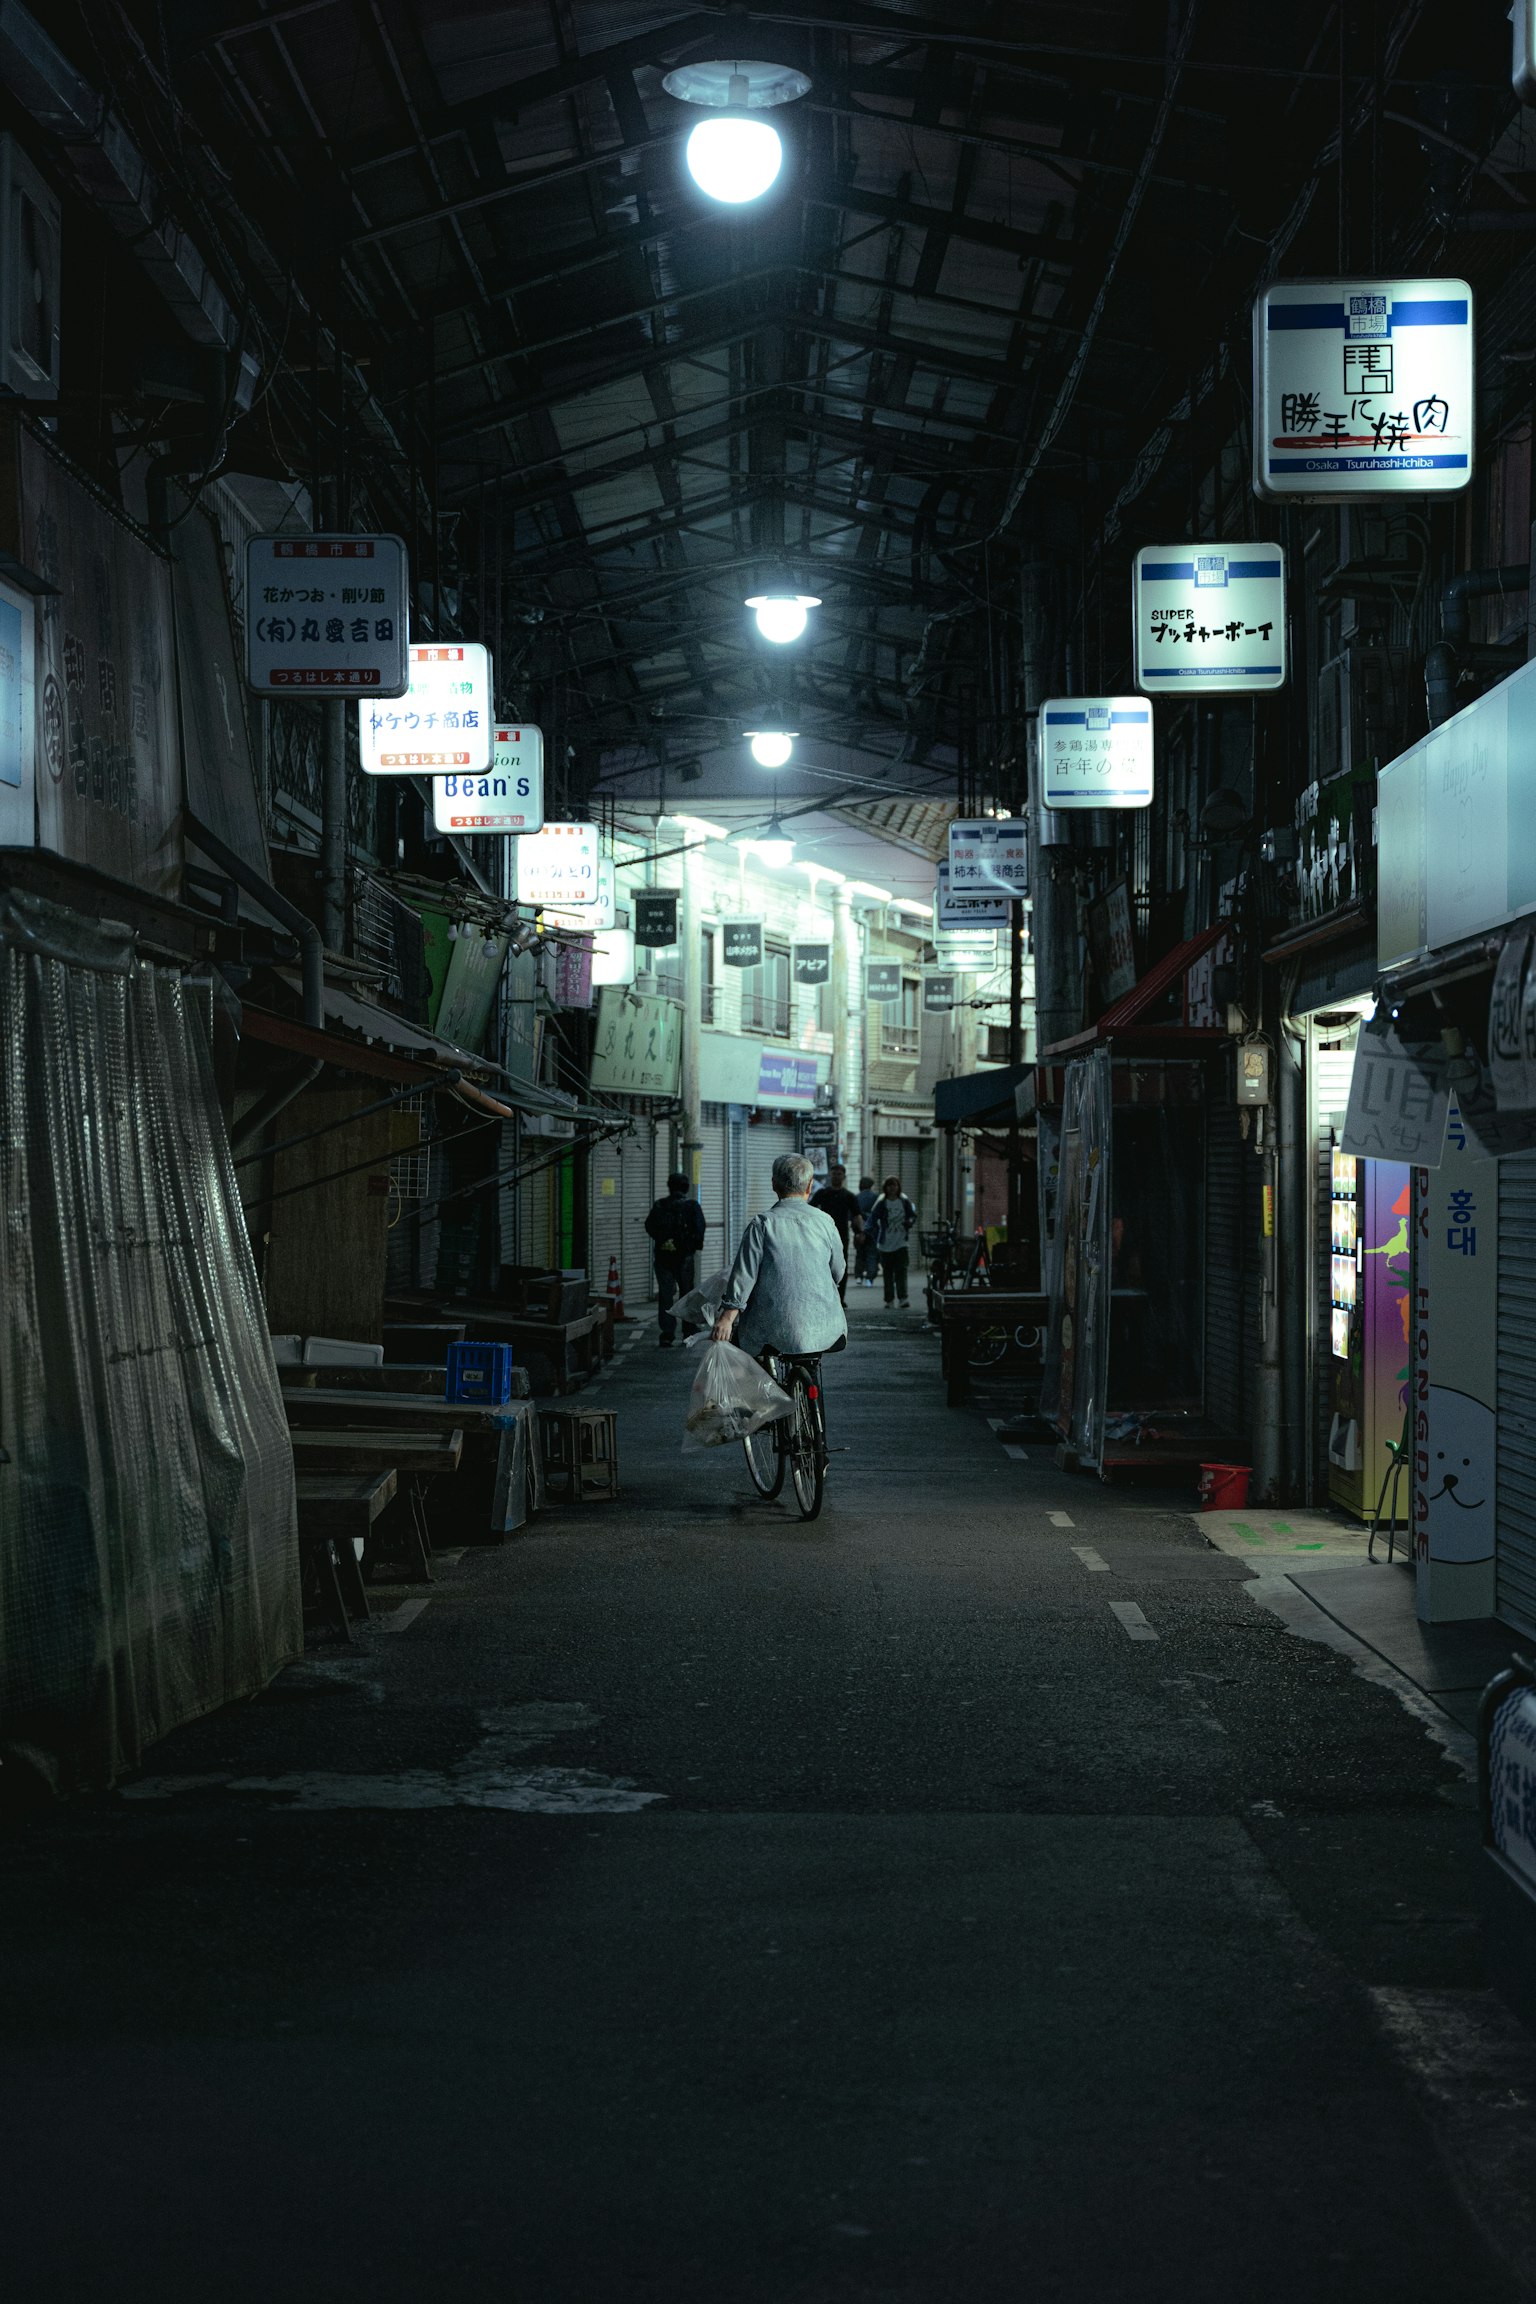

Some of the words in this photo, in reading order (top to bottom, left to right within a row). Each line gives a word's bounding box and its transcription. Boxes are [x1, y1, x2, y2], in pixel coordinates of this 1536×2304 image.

[1351, 297, 1385, 315] 鶴橋
[1351, 315, 1385, 333] 市場
[1281, 392, 1449, 452] 勝手に焼肉
[1306, 459, 1339, 470] Osaka
[1345, 457, 1434, 469] Tsuruhashi-Ichiba
[279, 543, 369, 557] 鶴橋市場
[263, 587, 385, 604] 花かつお・削り節
[1150, 609, 1195, 620] SUPER
[1150, 621, 1273, 643] ブッチャーボーイ
[277, 671, 374, 683] つるはし本通り
[369, 709, 480, 731] タケウチ商店
[385, 752, 466, 765] つるはし本通り
[444, 774, 531, 797] Bean's
[1447, 1188, 1476, 1256] 홍대
[1417, 1287, 1430, 1565] HONGDAE
